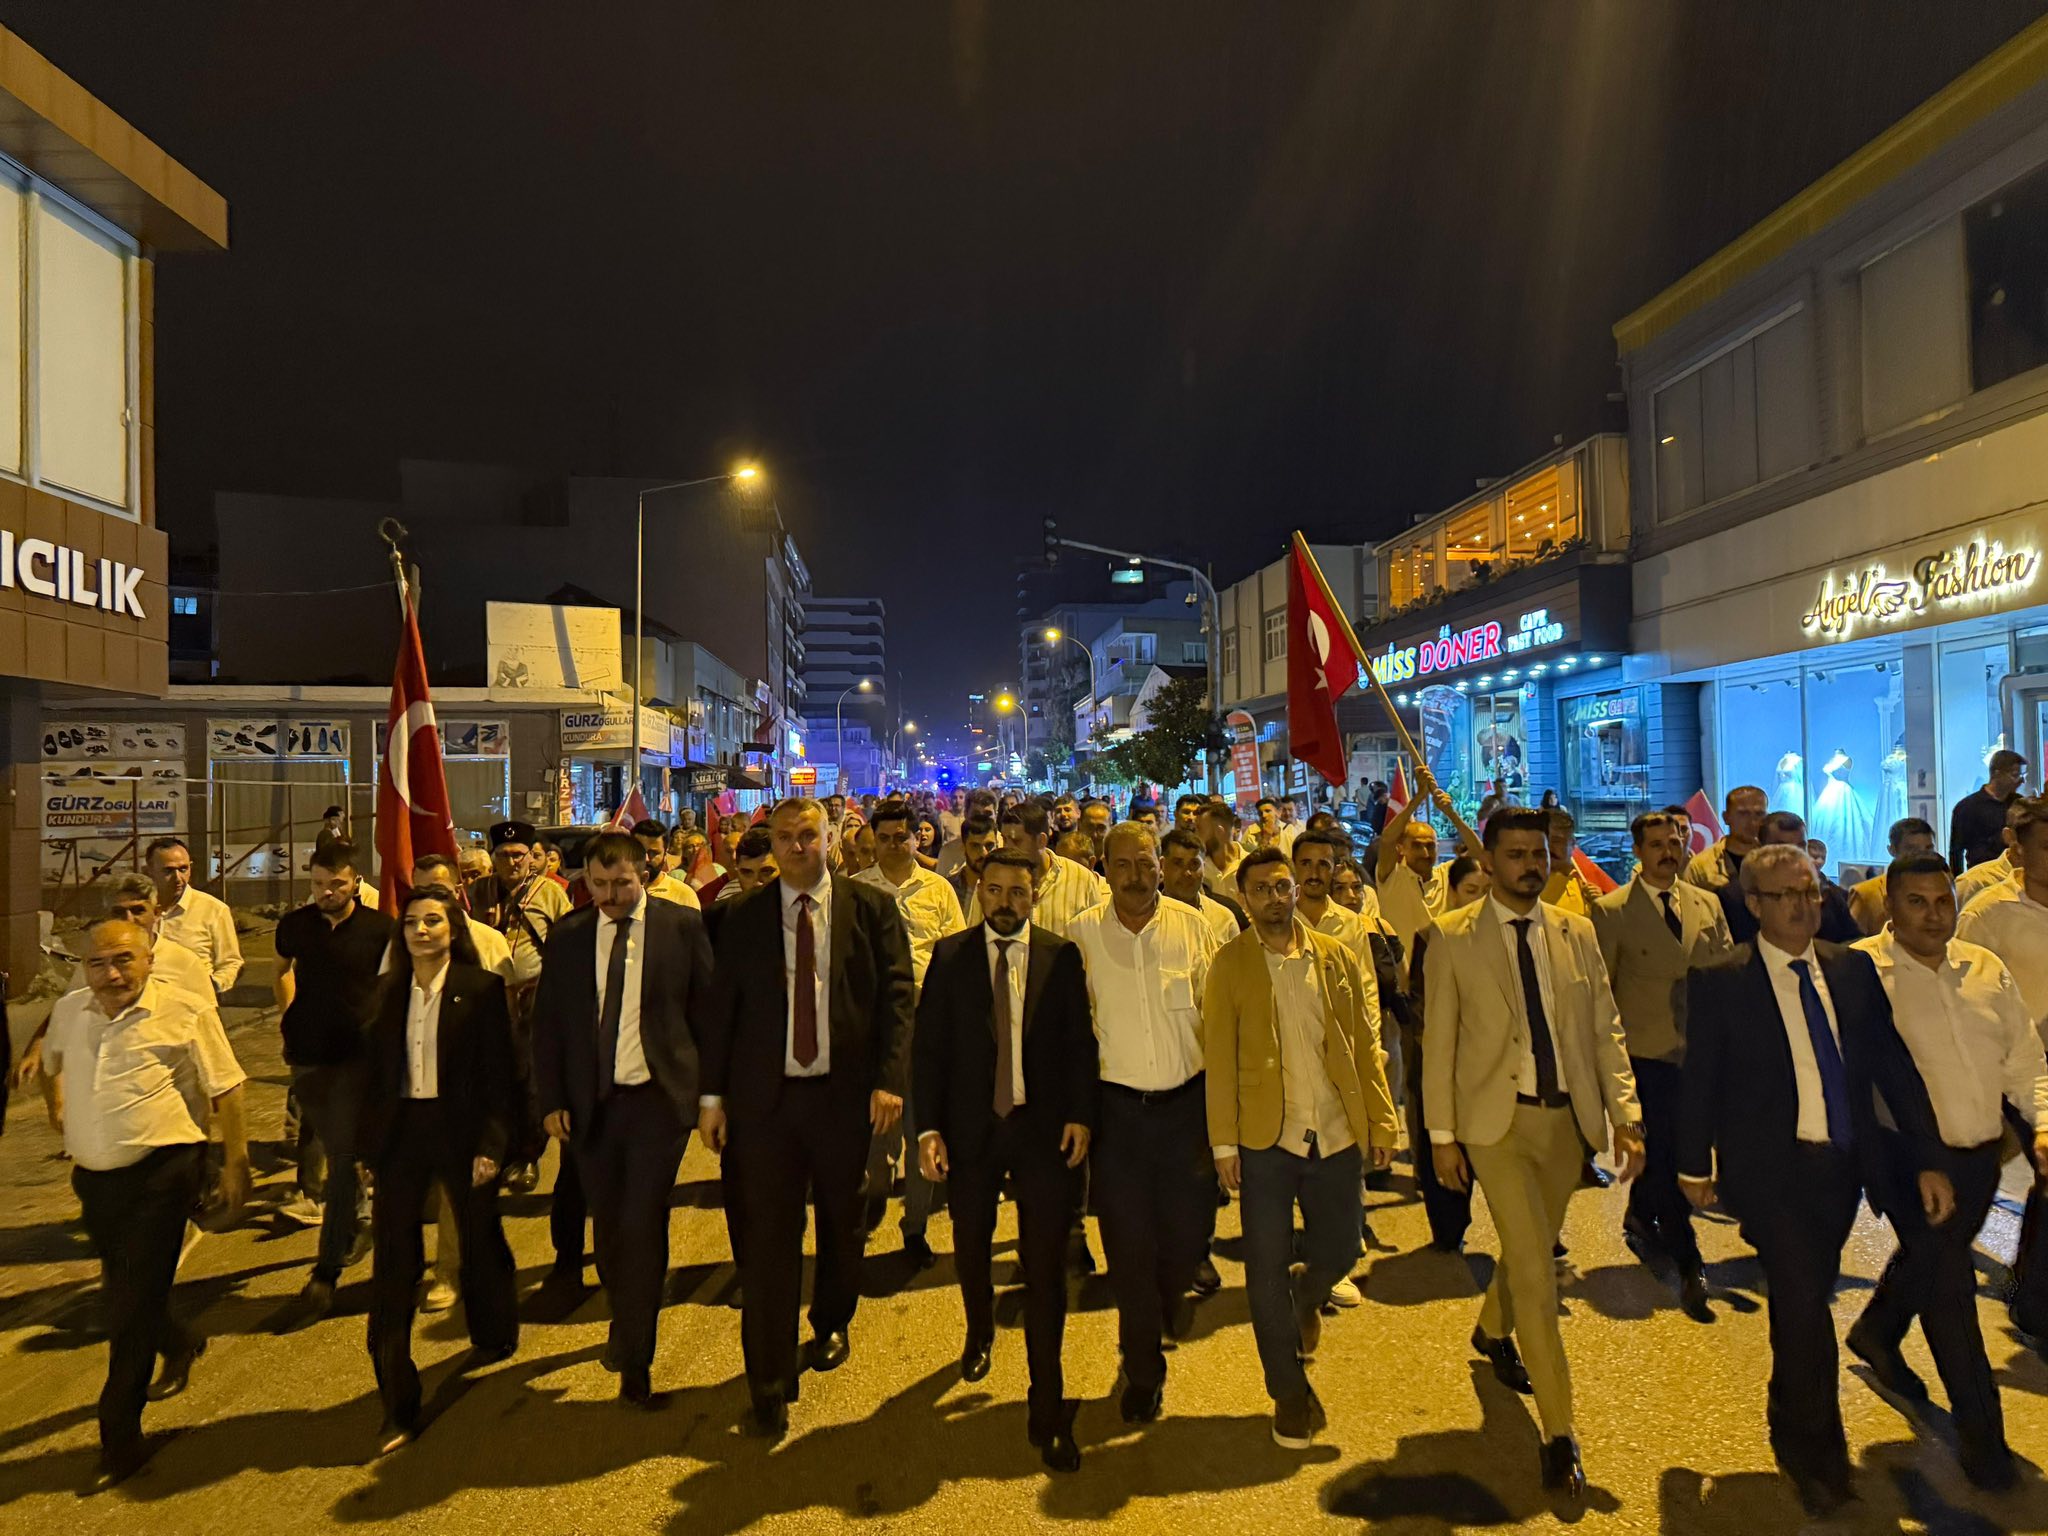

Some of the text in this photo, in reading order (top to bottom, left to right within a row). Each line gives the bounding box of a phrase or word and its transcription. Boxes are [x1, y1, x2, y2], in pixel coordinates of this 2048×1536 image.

[1801, 542, 2036, 633] Angel Fashion
[1418, 621, 1502, 674] DÖNER
[1507, 622, 1564, 653] FAST FOOD
[562, 731, 603, 744] KUNDURA
[48, 813, 113, 826] KUNDURA
